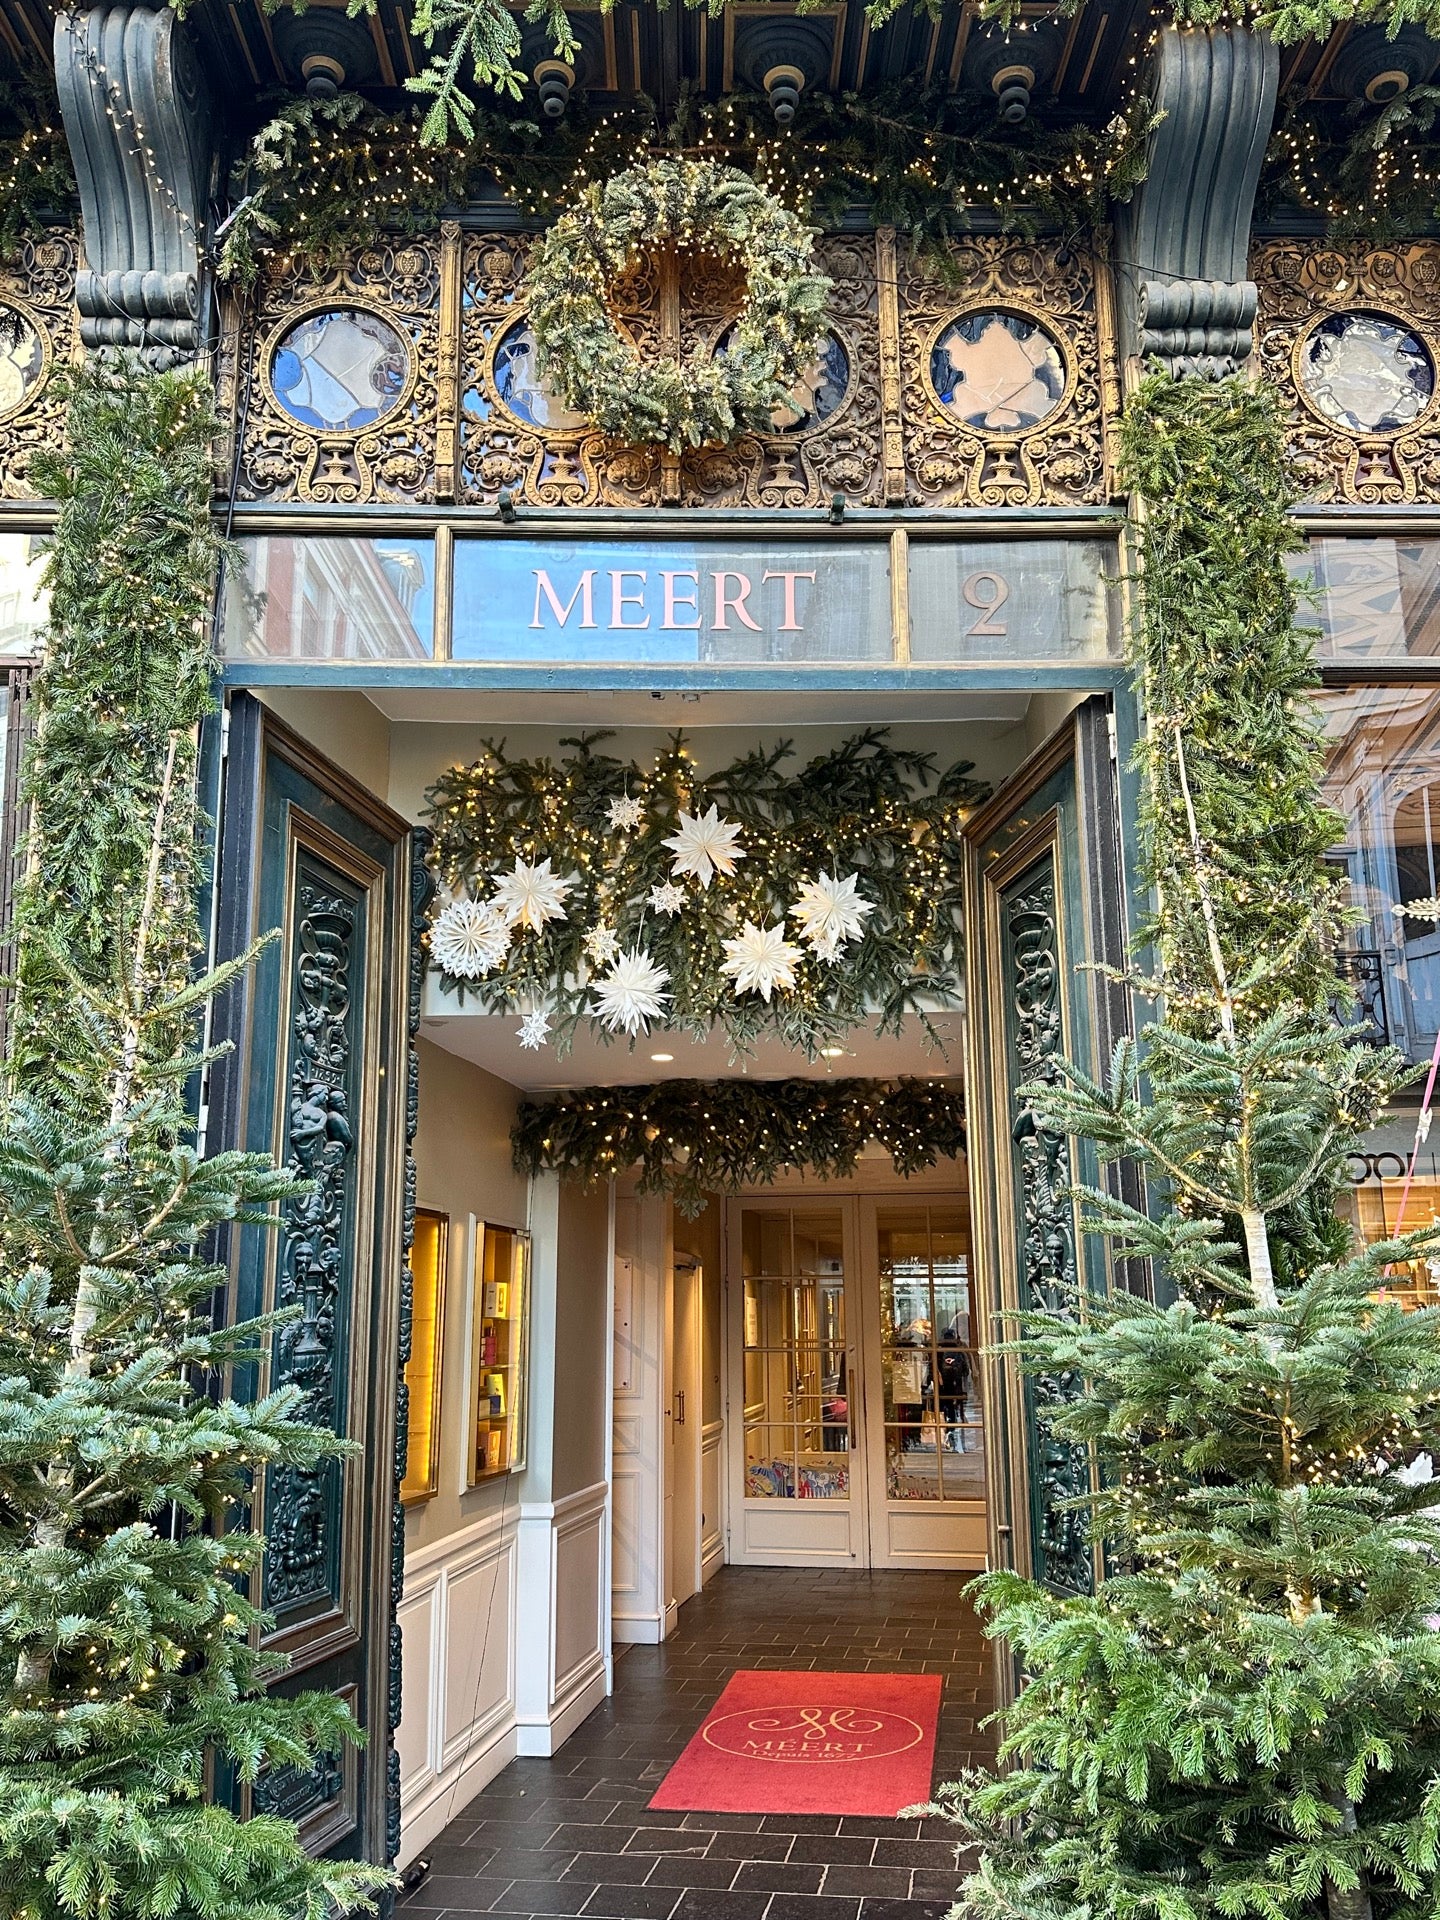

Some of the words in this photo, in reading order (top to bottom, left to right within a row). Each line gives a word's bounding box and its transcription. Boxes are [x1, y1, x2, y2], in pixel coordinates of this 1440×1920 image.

[527, 569, 816, 631] MEERT
[962, 570, 1010, 635] 2
[752, 1749, 810, 1759] Depuis
